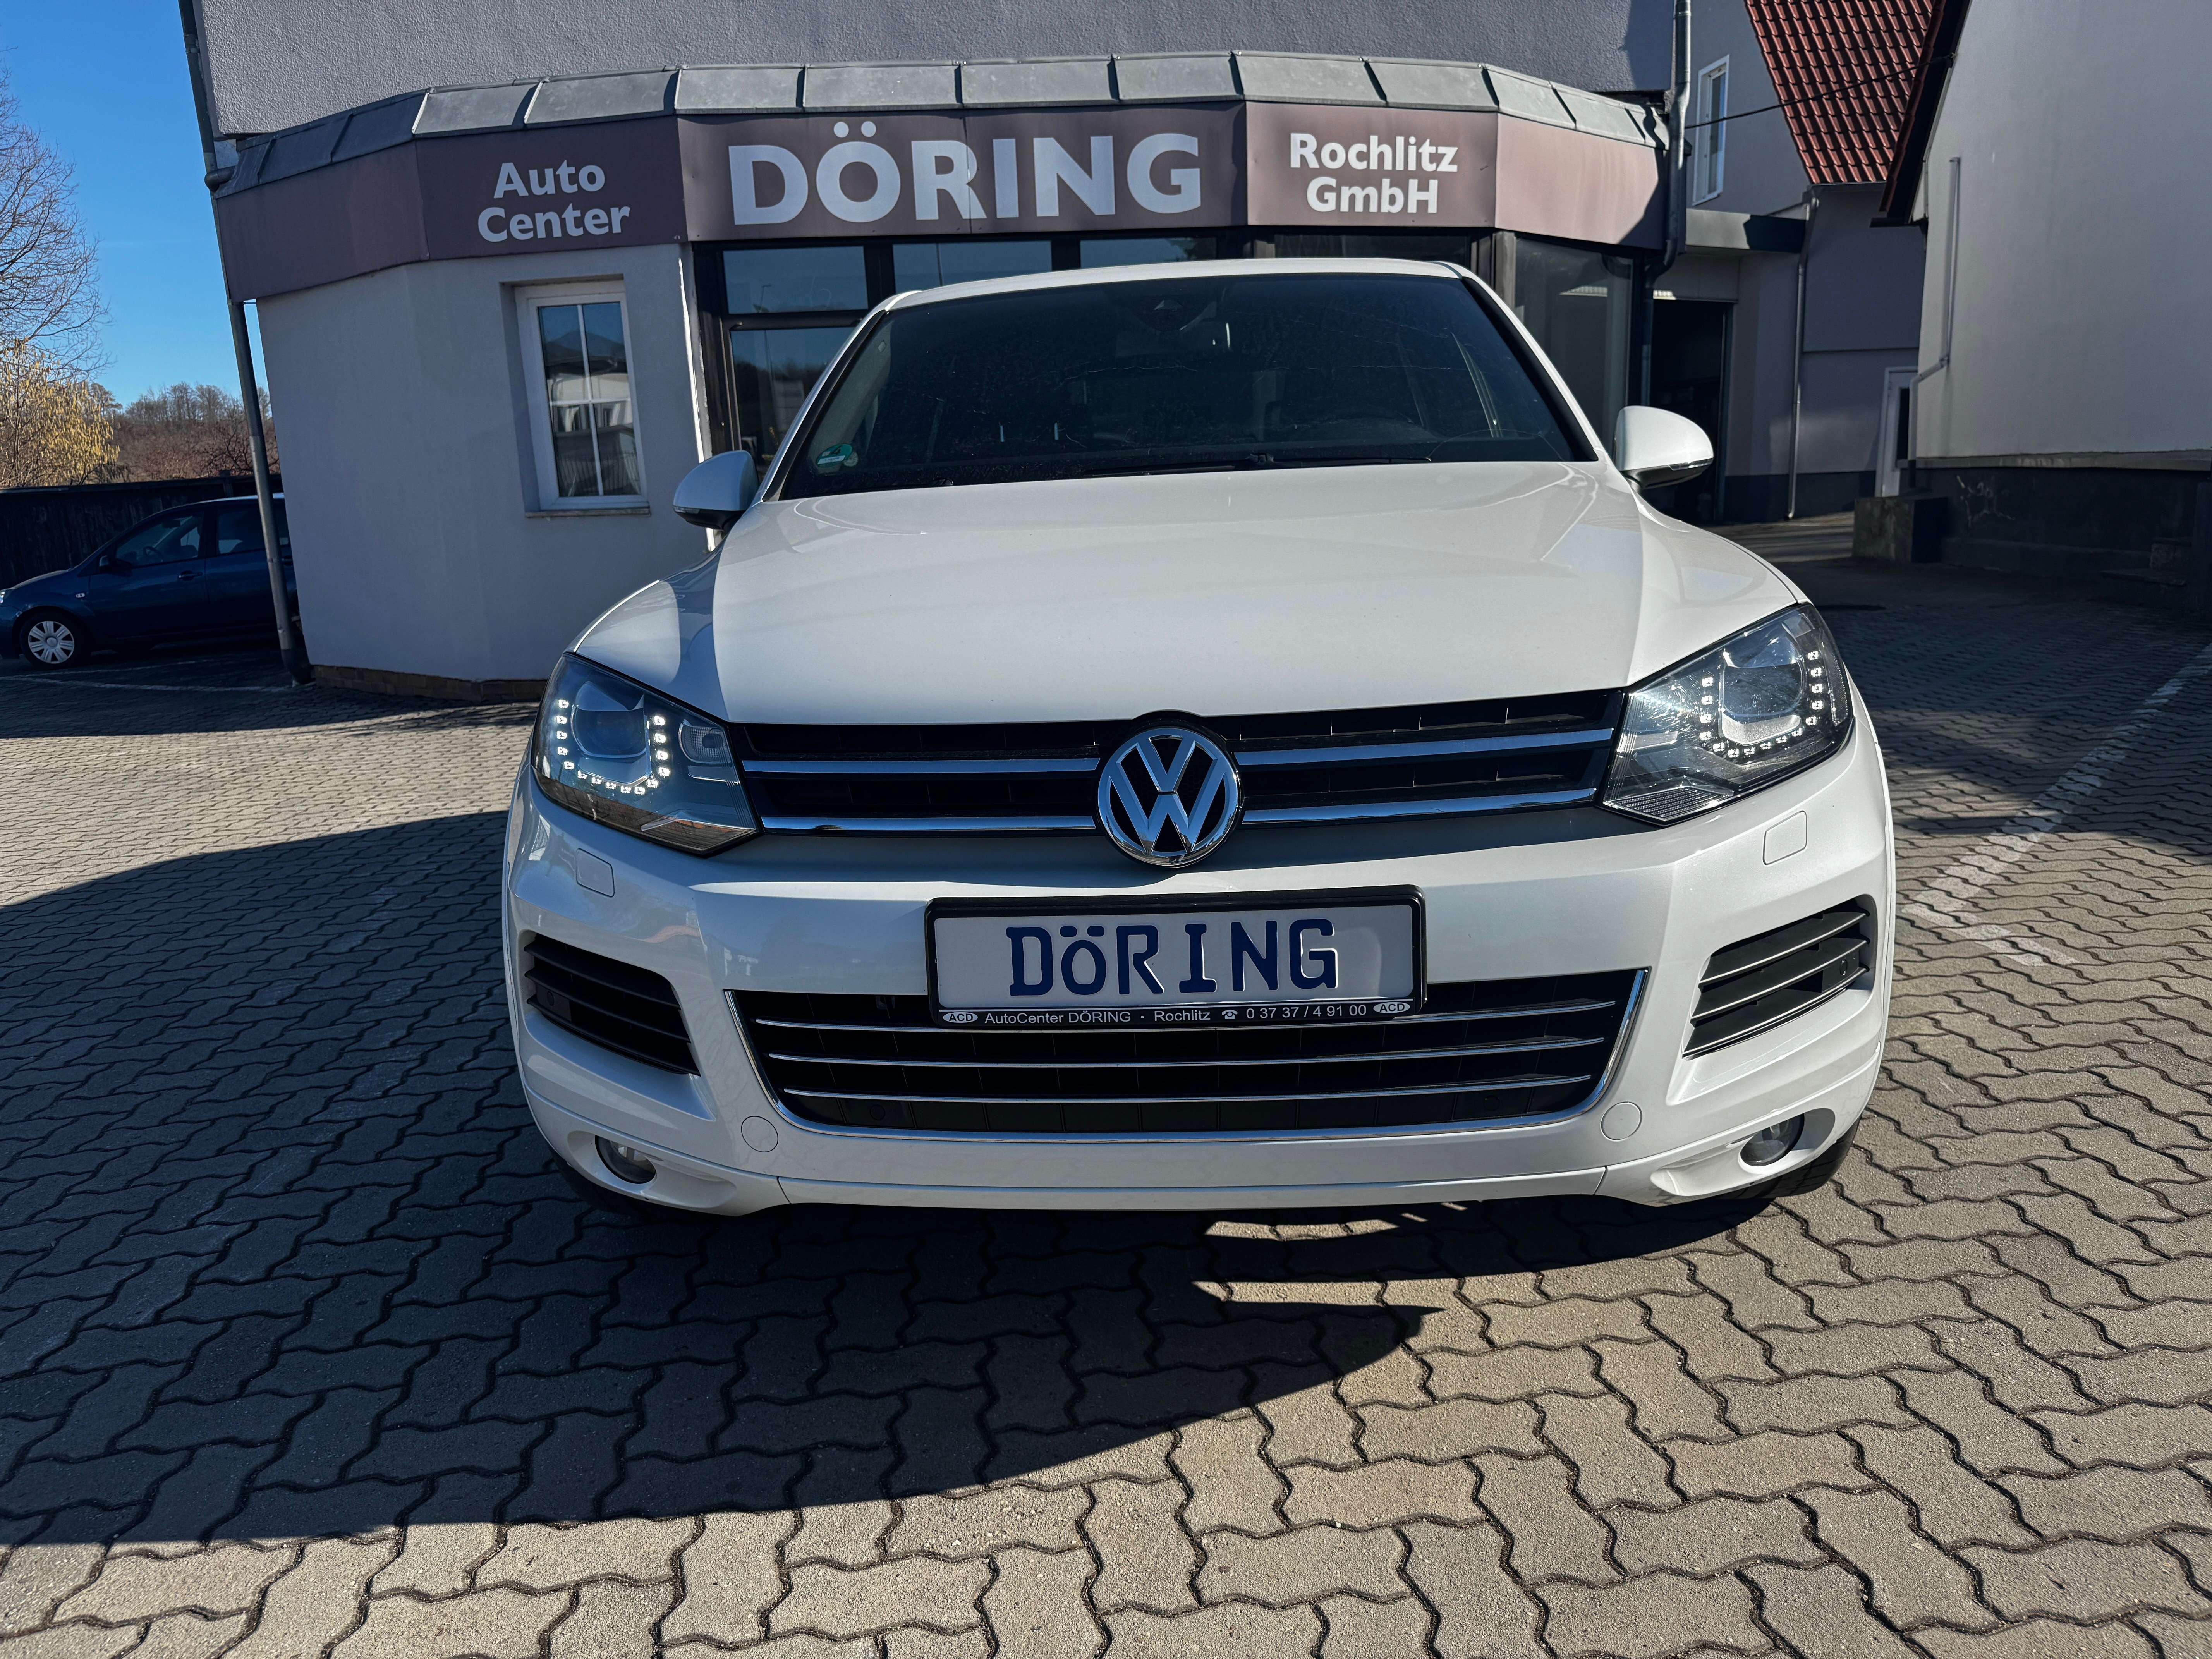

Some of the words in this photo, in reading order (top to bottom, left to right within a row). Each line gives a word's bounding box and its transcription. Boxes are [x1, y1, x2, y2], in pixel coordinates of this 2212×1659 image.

[1290, 132, 1458, 172] Rochlitz
[493, 159, 605, 199] Auto
[728, 121, 1201, 225] DÖRING
[1306, 176, 1438, 213] GmbH
[477, 203, 630, 242] Center
[1102, 730, 1235, 860] VW
[1006, 918, 1338, 996] DÖRING
[948, 1013, 974, 1022] ACD
[984, 1012, 1064, 1024] AutoCenter
[1068, 1010, 1131, 1023] DÖRING
[1154, 1009, 1211, 1022] Rochlitz
[1246, 1009, 1255, 1020] 0
[1259, 1008, 1277, 1019] 37
[1281, 1007, 1299, 1018] 37
[1304, 1006, 1309, 1018] /
[1312, 1006, 1322, 1017] 4
[1327, 1005, 1343, 1017] 91
[1349, 1005, 1367, 1016] 00
[1379, 1003, 1405, 1013] ACD
